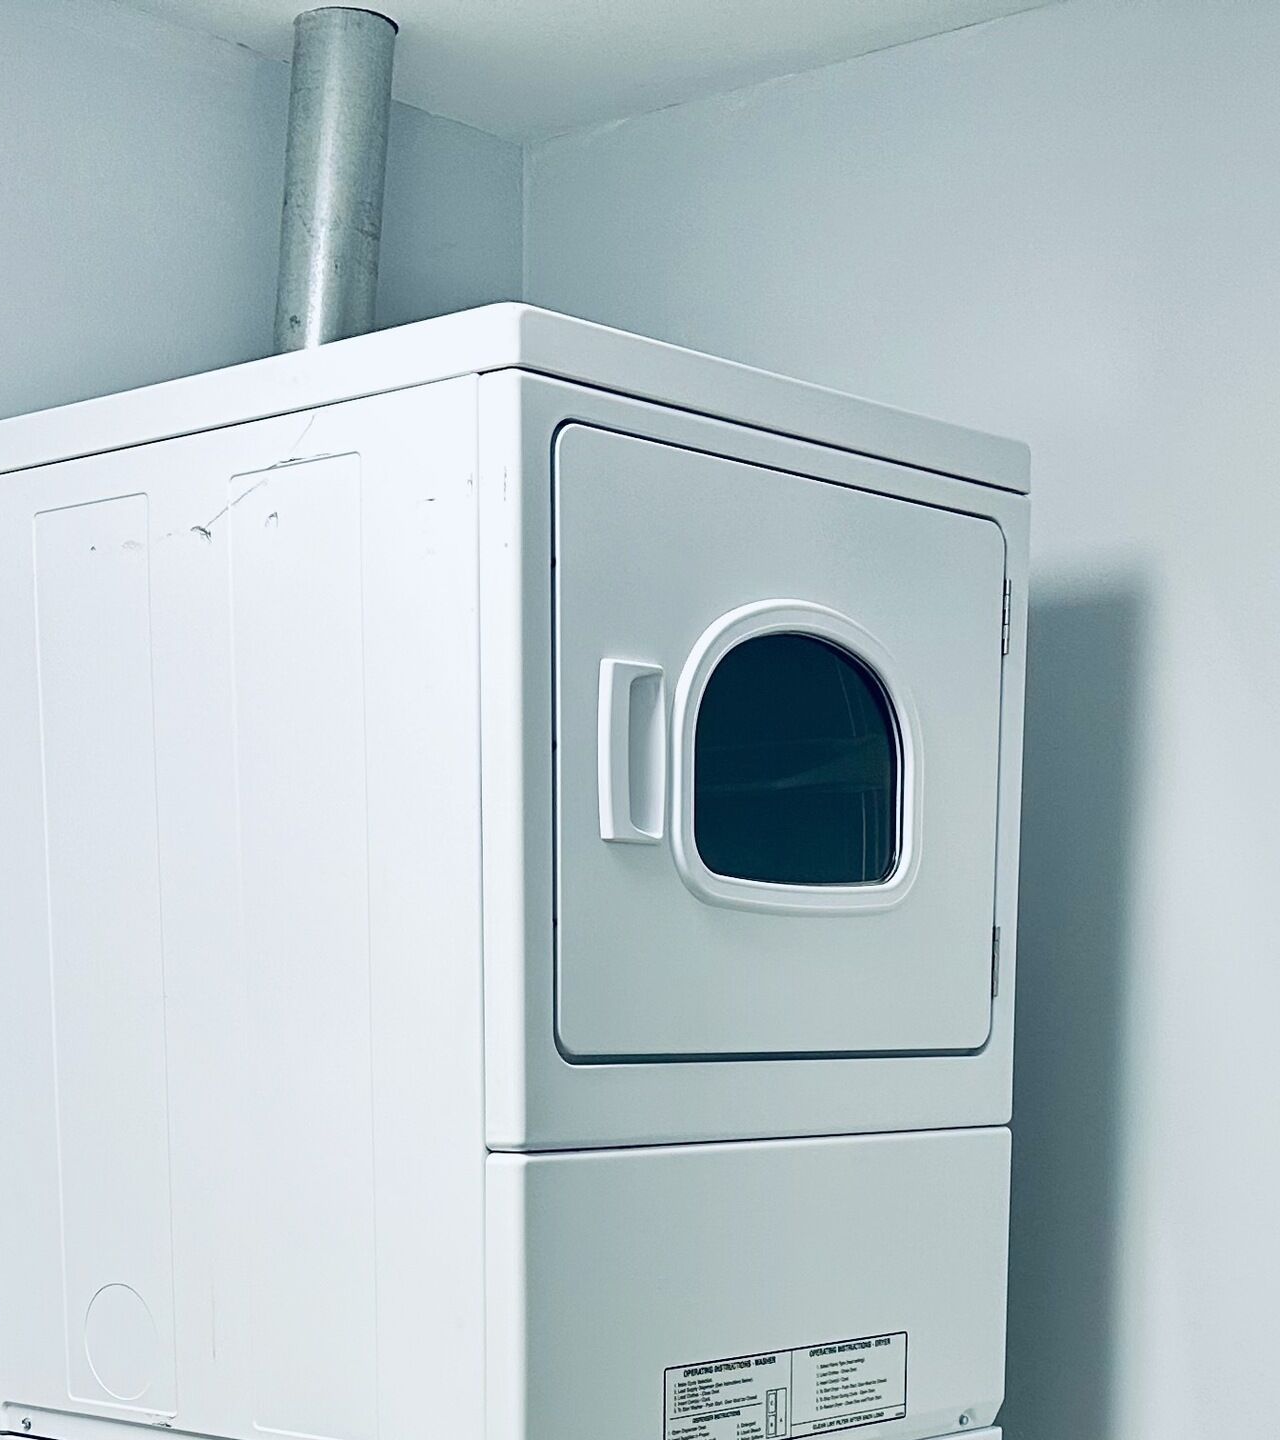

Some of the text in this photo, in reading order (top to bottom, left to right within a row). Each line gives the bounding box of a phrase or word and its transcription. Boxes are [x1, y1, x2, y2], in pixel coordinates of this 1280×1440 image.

[809, 1346, 837, 1358] OPERATING
[837, 1340, 872, 1353] INSTRUCTIONS
[874, 1337, 891, 1348] DRYER
[683, 1365, 714, 1378] OPERATING
[714, 1360, 752, 1373] INSTRUCTIONS
[755, 1355, 777, 1367] WASHER
